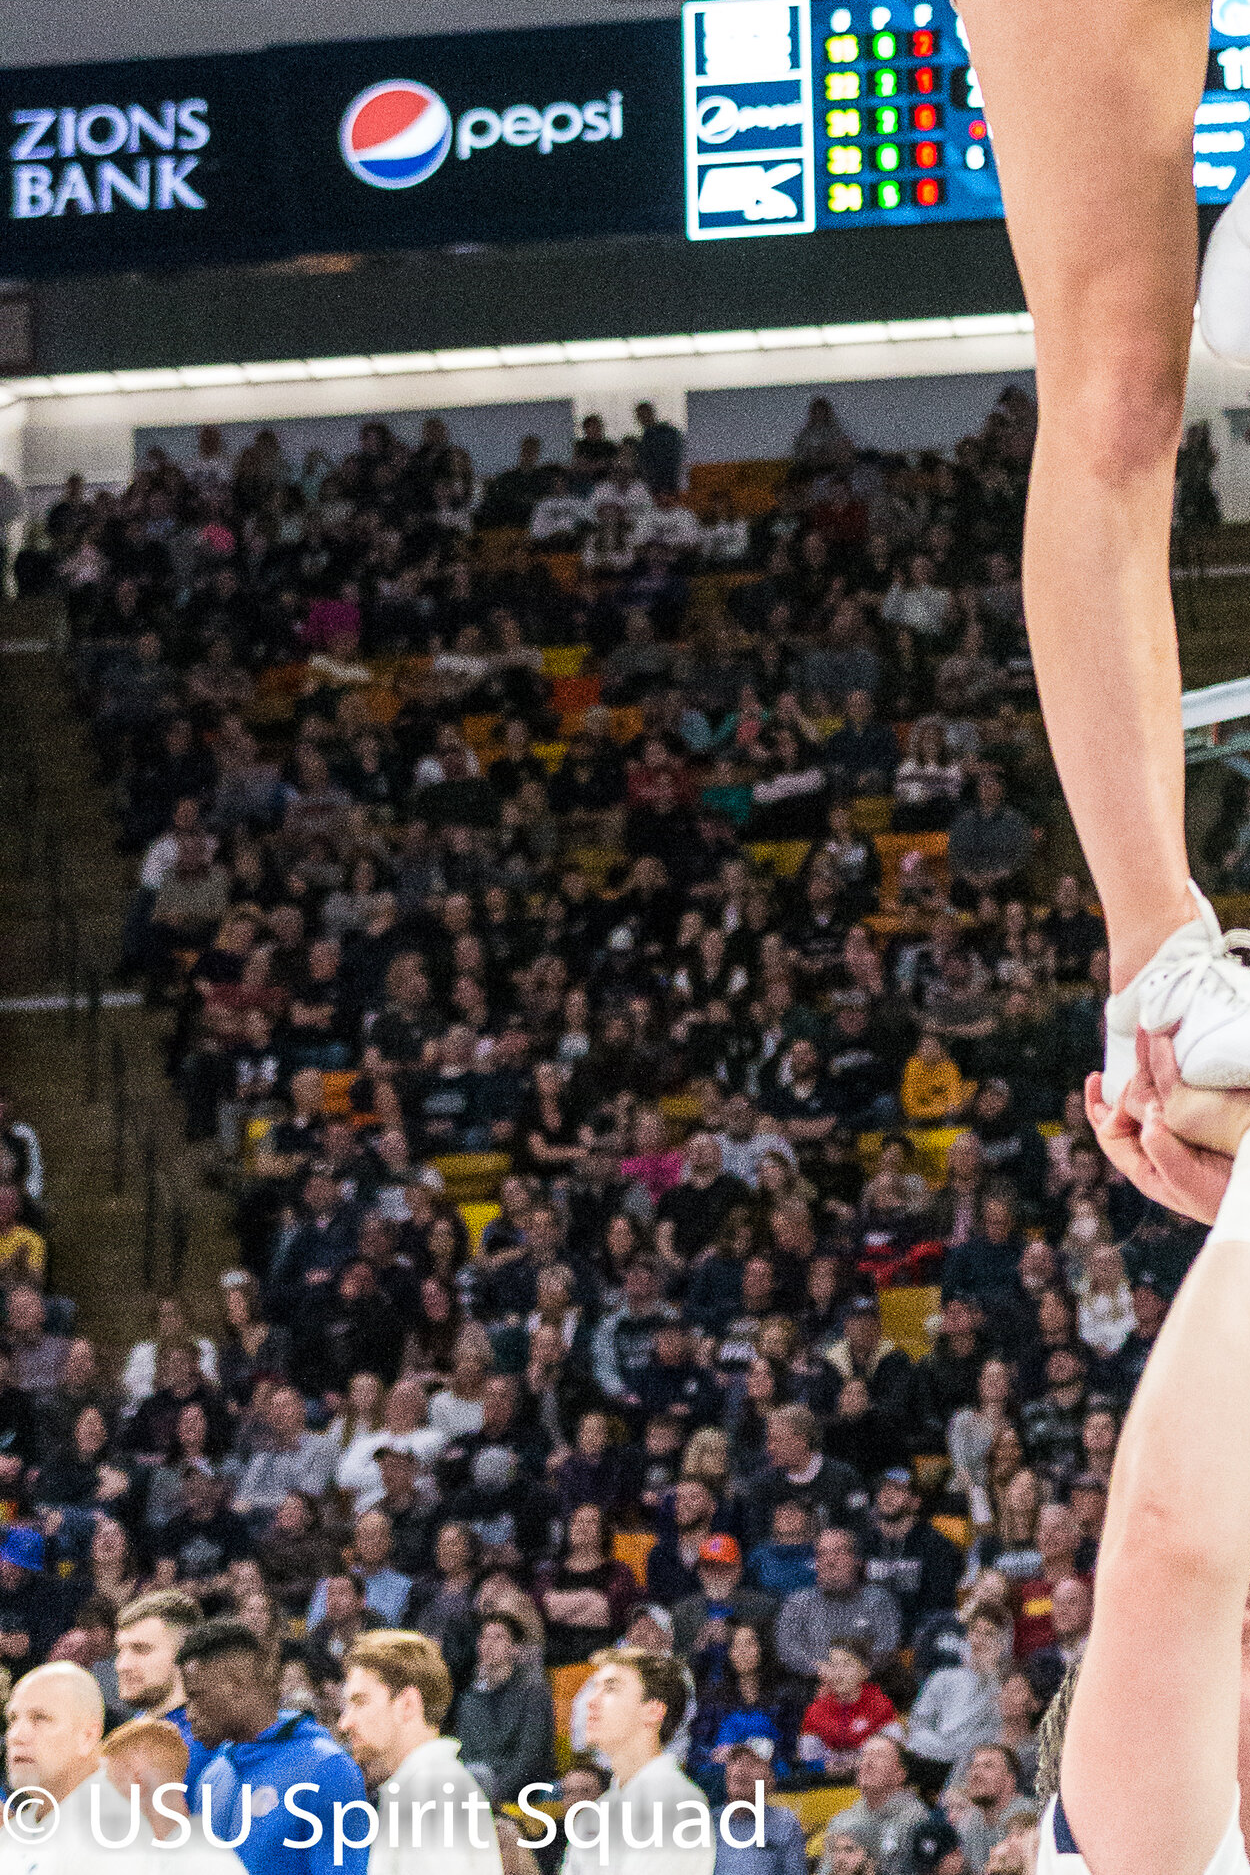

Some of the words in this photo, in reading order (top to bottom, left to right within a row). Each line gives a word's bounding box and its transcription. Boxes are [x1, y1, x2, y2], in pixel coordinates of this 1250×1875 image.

[10, 98, 211, 161] ZIONS
[456, 89, 625, 160] pepsi
[11, 155, 208, 219] BANK
